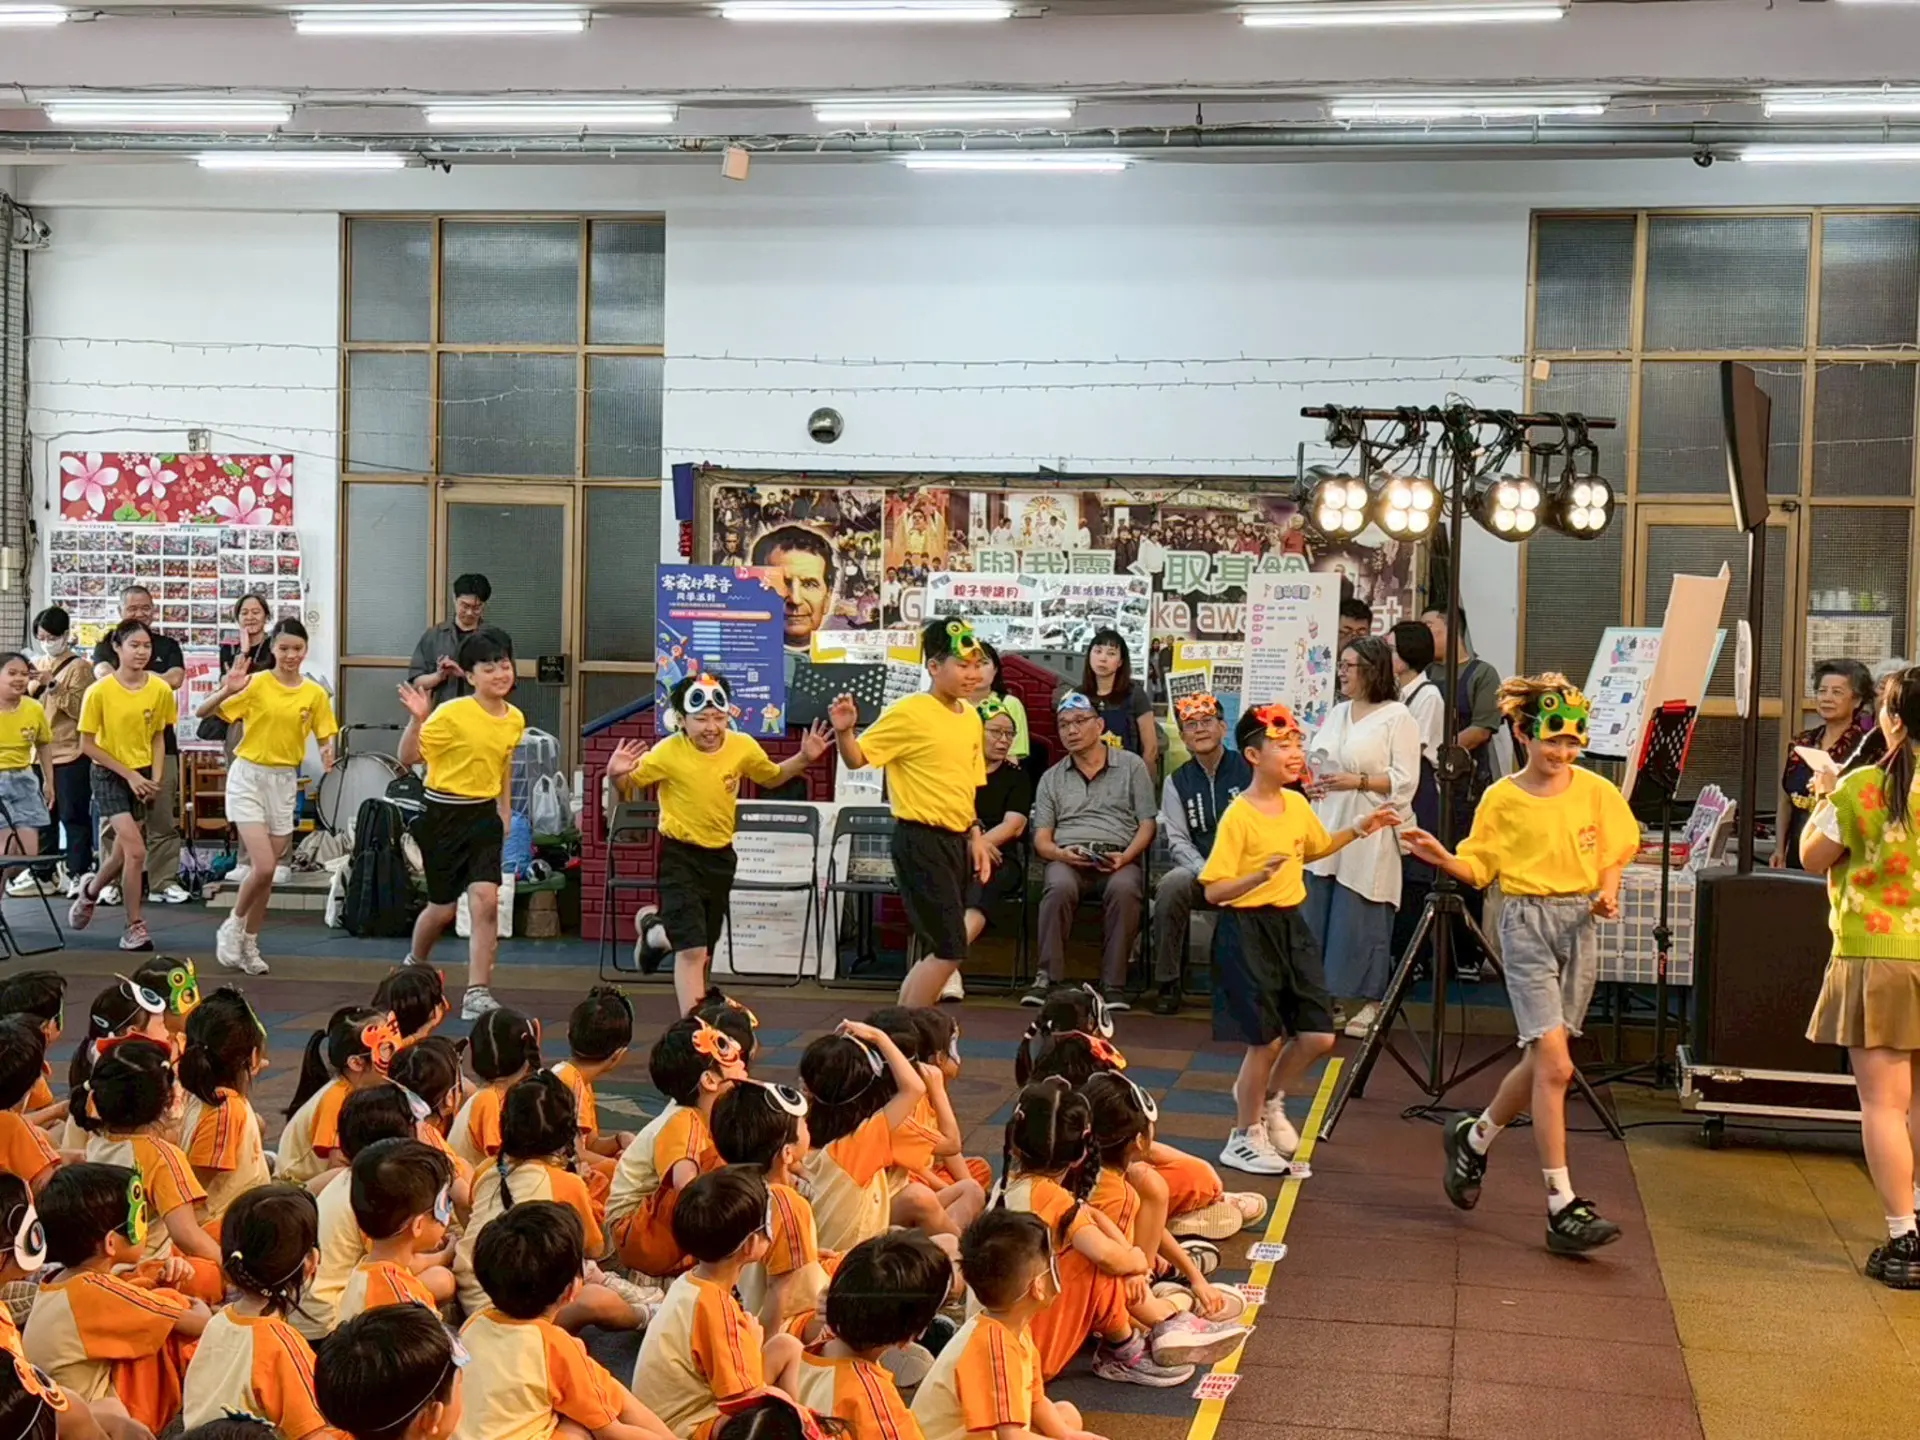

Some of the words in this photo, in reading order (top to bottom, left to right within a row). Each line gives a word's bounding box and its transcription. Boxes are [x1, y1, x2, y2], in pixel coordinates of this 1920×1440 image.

[661, 572, 733, 594] 客家好聲音
